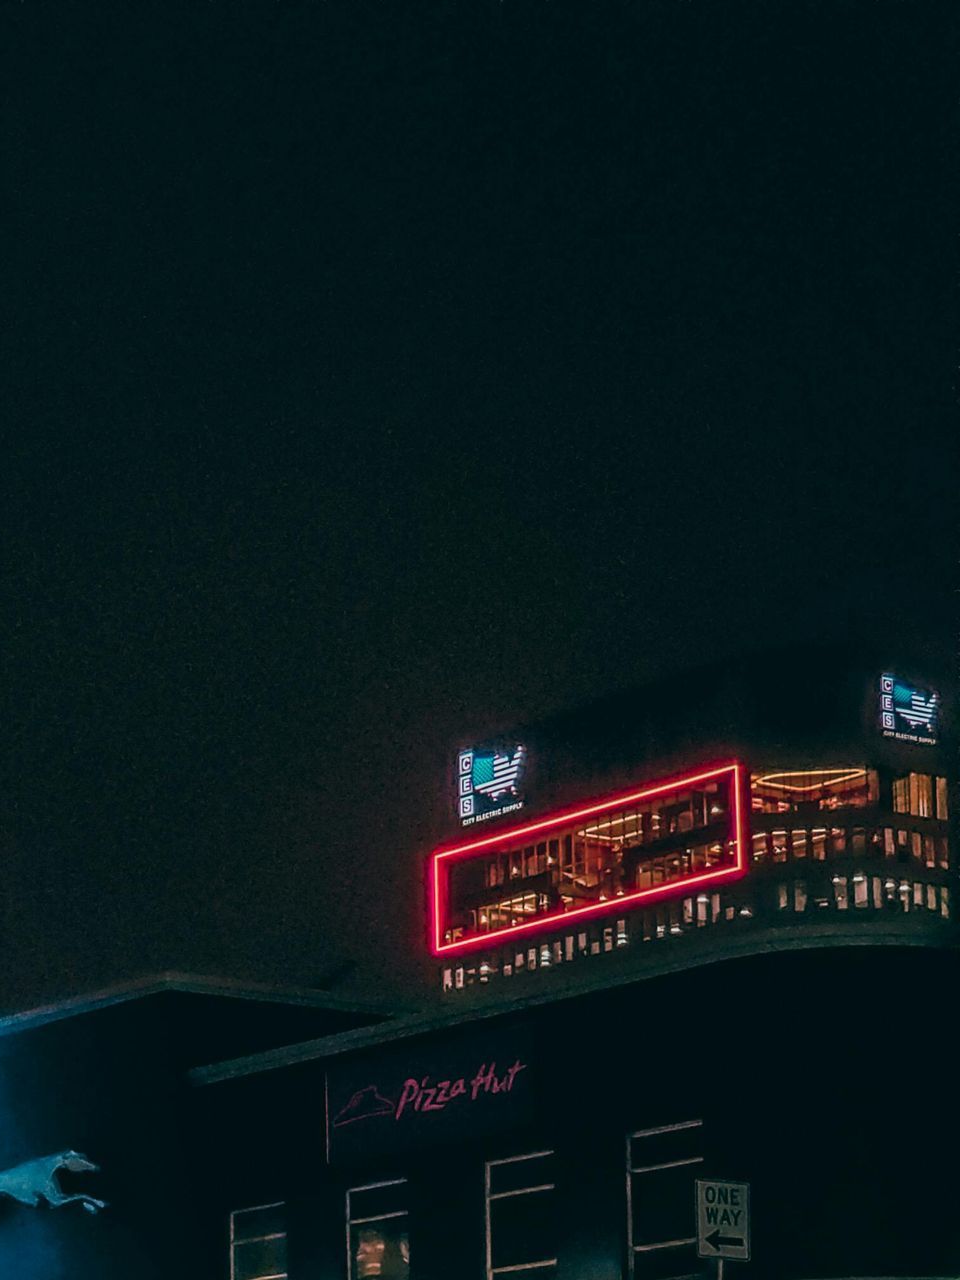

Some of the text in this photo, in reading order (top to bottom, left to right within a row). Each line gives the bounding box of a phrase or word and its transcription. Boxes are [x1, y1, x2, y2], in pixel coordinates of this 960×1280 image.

[461, 753, 473, 816] CES
[462, 801, 524, 827] CITY ELECTRIC SUPPLY
[395, 1059, 527, 1120] Pizza Hut
[705, 1186, 739, 1206] ONE
[706, 1207, 741, 1226] WAY
